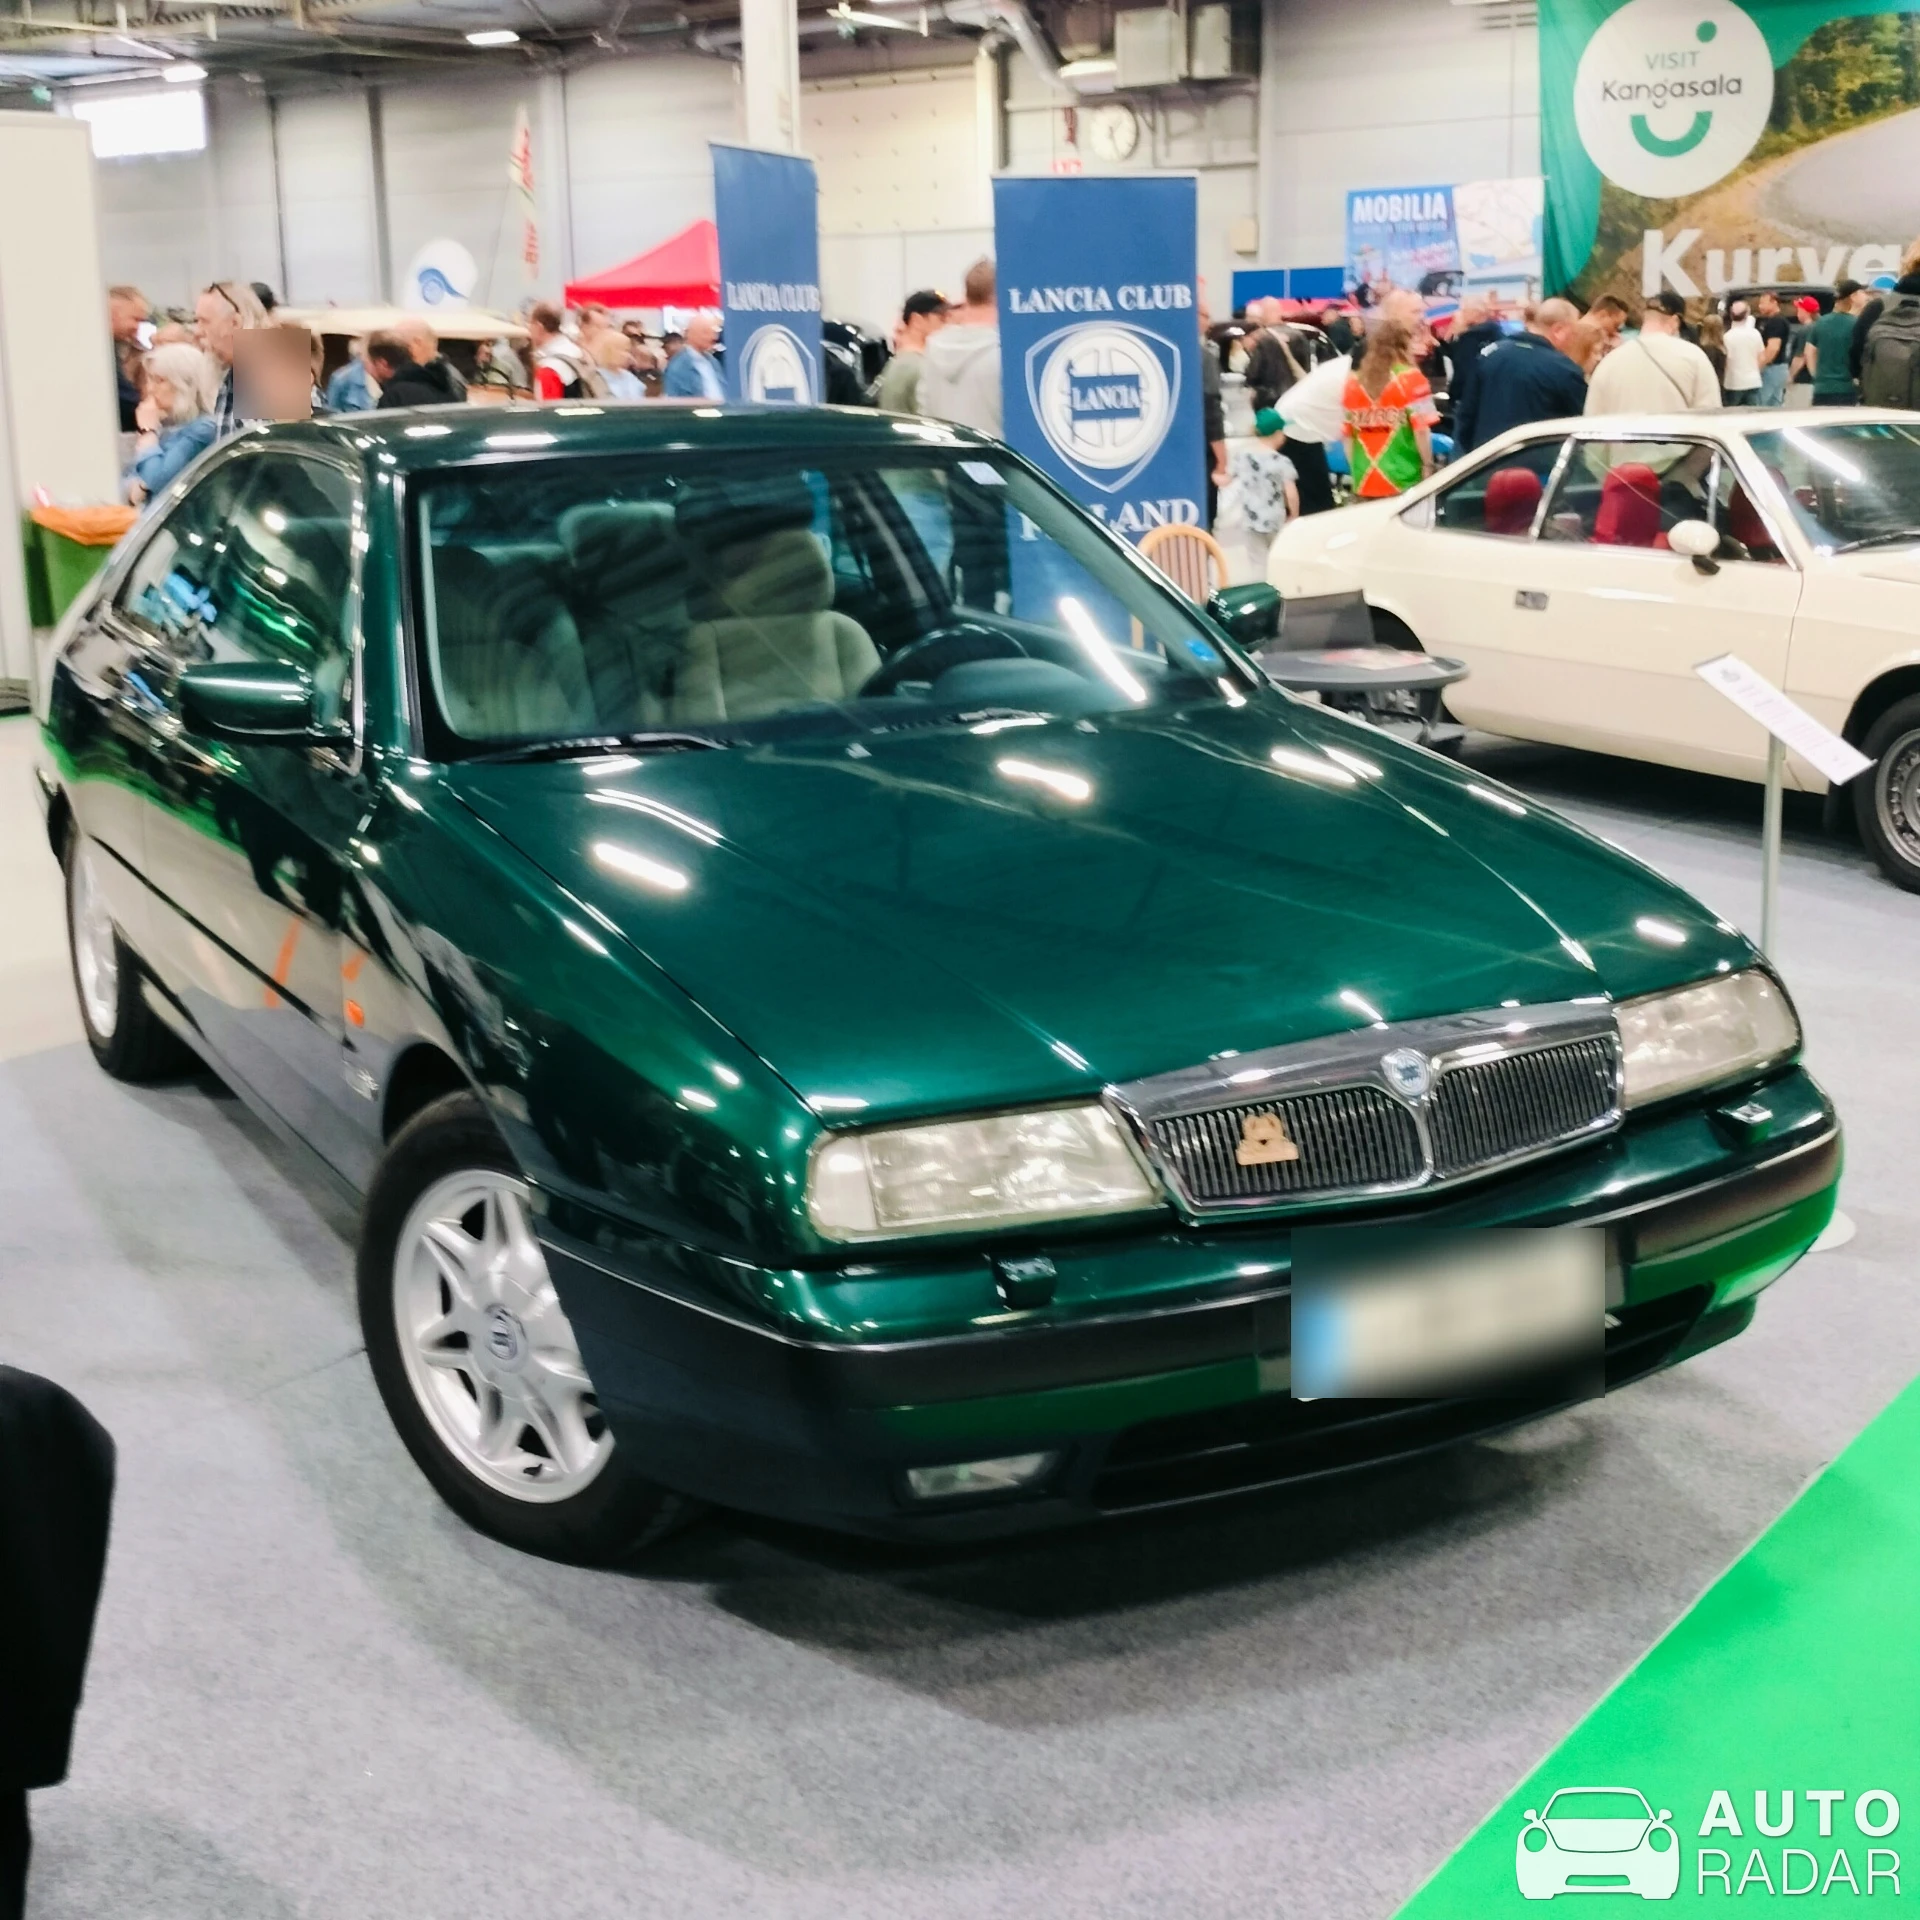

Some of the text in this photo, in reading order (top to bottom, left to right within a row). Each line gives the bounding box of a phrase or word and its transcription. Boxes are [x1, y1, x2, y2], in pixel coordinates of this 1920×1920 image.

[1644, 50, 1701, 71] VISIT
[1602, 73, 1742, 109] Kangasala
[1353, 191, 1448, 224] MOBILIA
[1008, 284, 1193, 314] LANCIA CLUB
[1072, 383, 1141, 412] LANCIA
